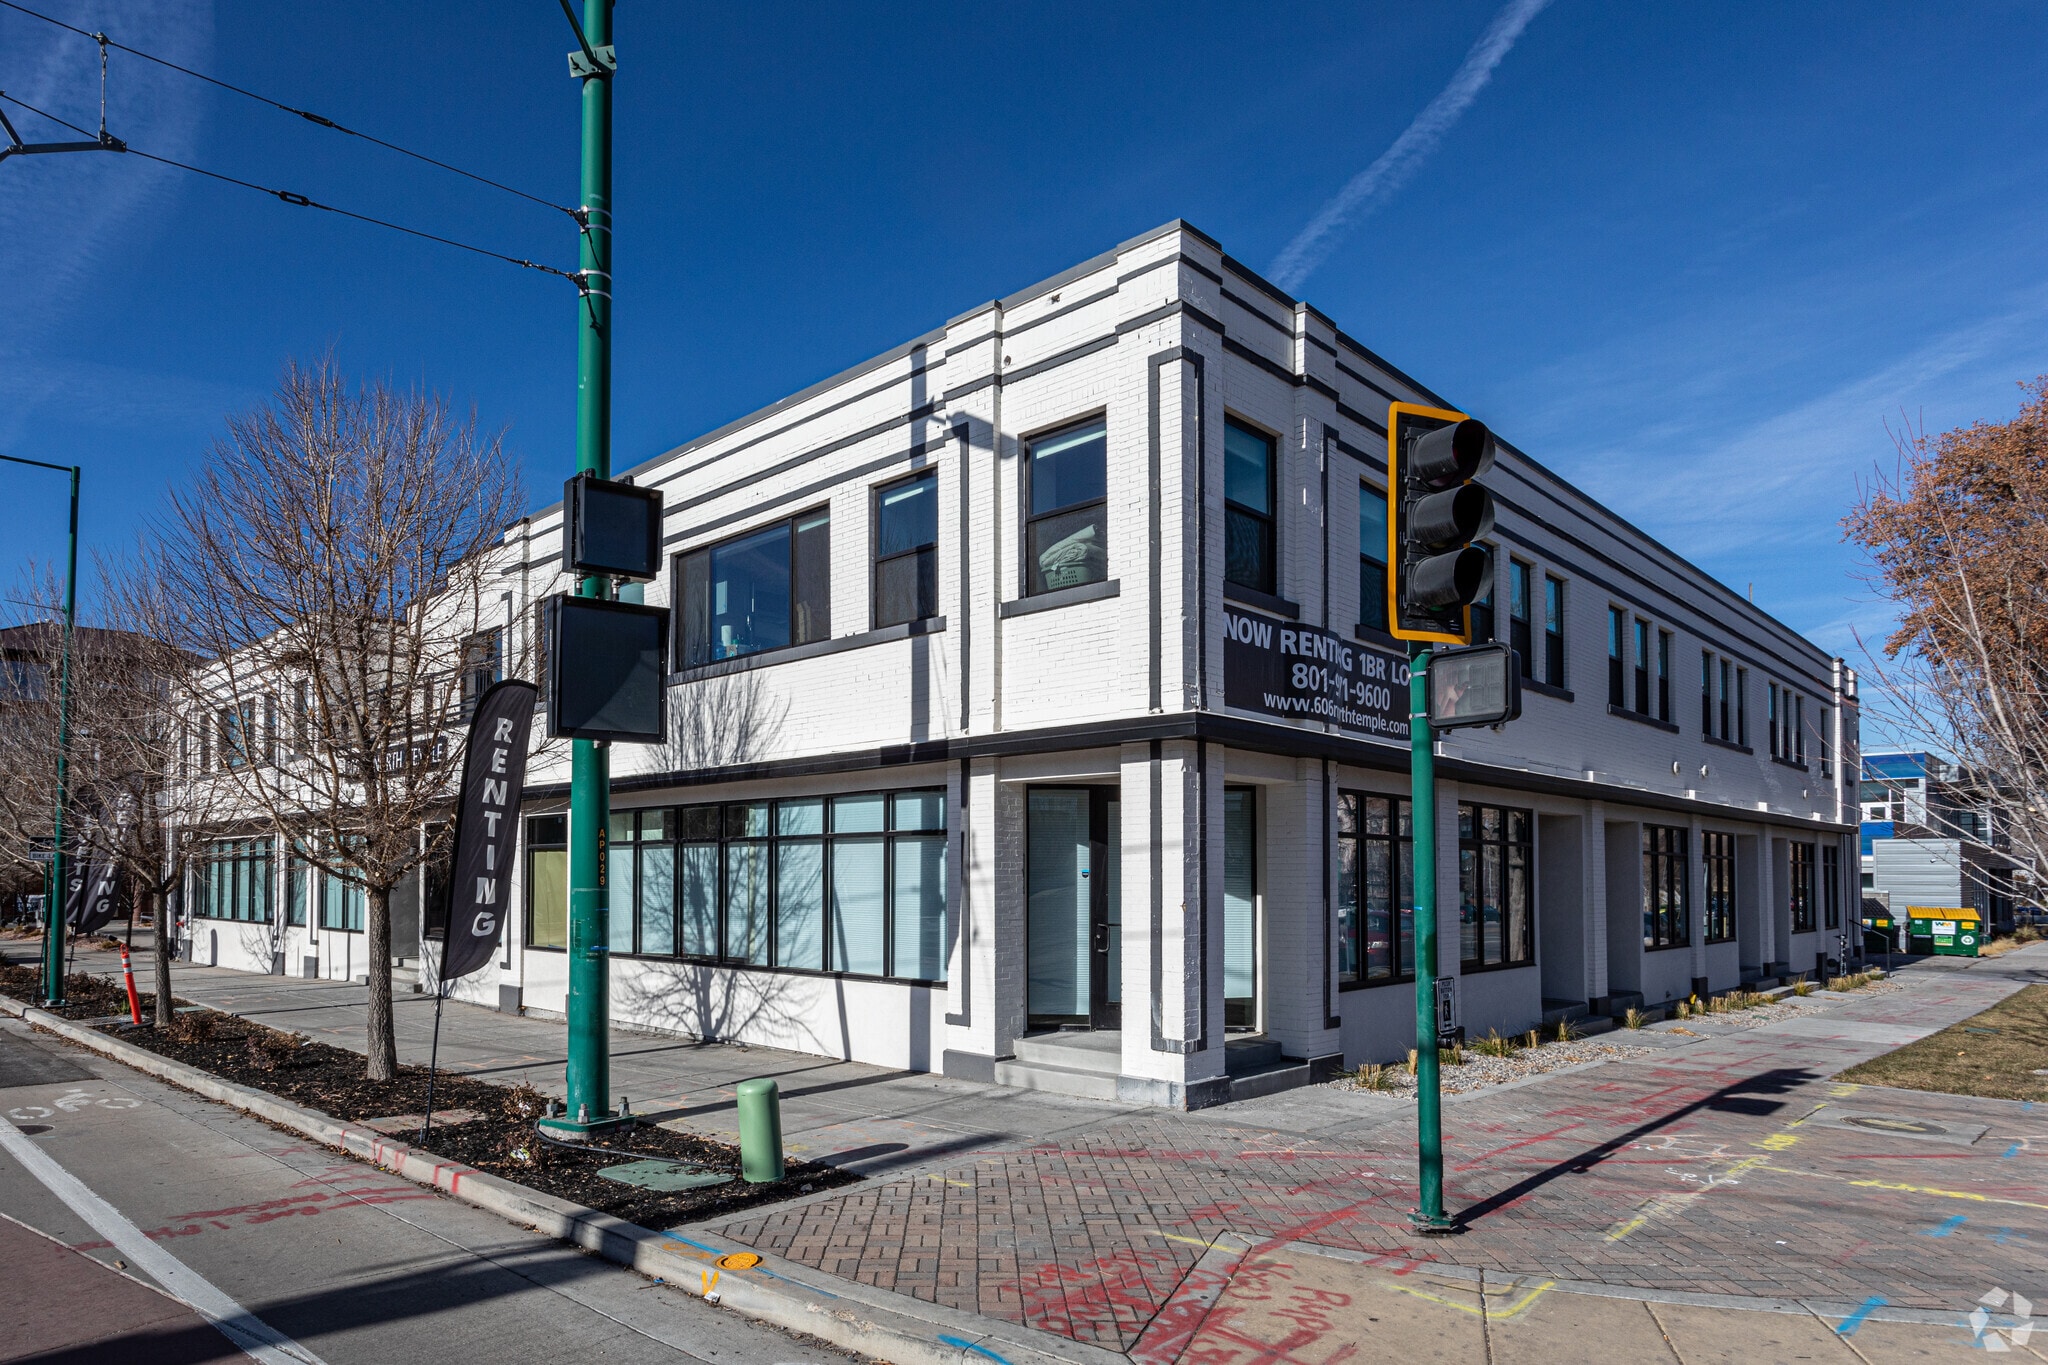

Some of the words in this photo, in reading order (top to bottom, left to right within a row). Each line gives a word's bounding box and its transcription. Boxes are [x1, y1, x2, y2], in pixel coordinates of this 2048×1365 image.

[1224, 611, 1272, 649] NOW
[1359, 652, 1386, 681] 1BR
[373, 750, 403, 772] NRTH
[471, 717, 513, 937] RENTING
[598, 828, 606, 886] AP029
